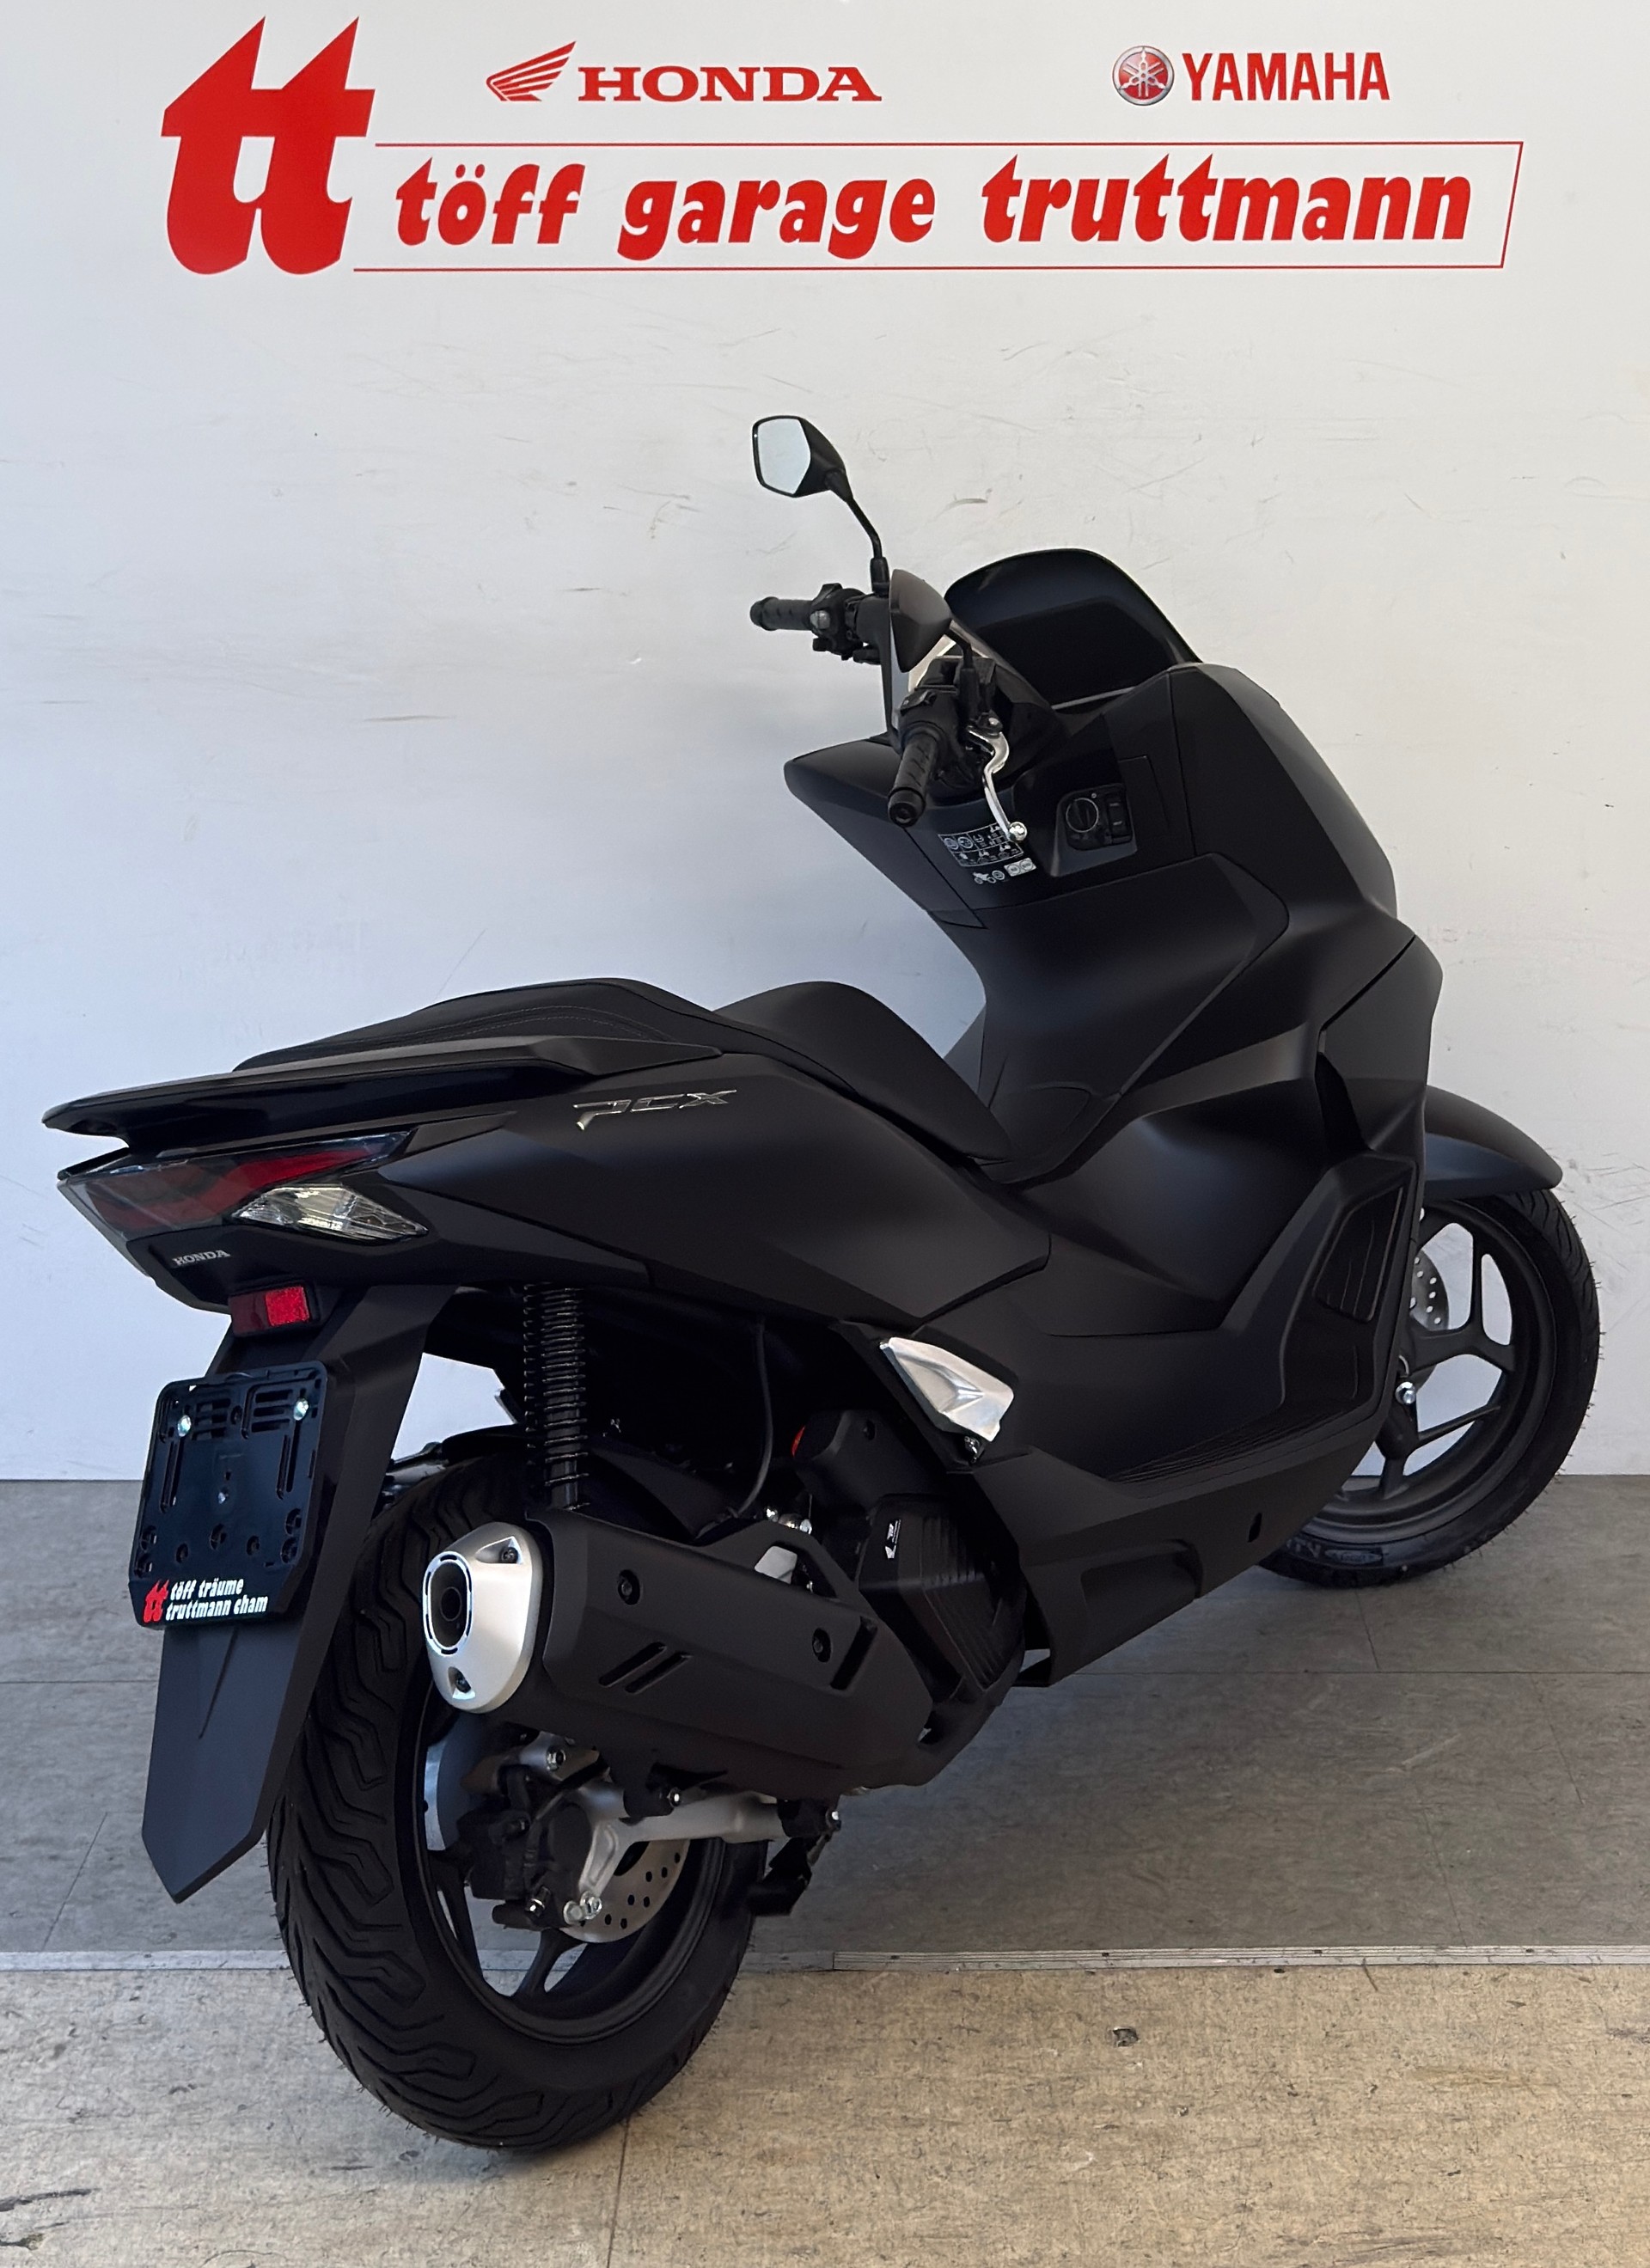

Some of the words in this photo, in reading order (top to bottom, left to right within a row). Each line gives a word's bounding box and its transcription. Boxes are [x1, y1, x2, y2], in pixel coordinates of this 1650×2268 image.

[578, 65, 882, 102] HONDA
[1182, 52, 1390, 101] YAMAHA
[395, 157, 586, 247] töff
[617, 177, 936, 261] garage
[981, 154, 1472, 244] truttmann
[573, 1089, 737, 1131] PCX
[172, 1250, 231, 1266] HONDA
[165, 1599, 232, 1621] truttmann
[233, 1594, 269, 1615] cham
[170, 1579, 197, 1601] töff
[198, 1577, 244, 1599] träume
